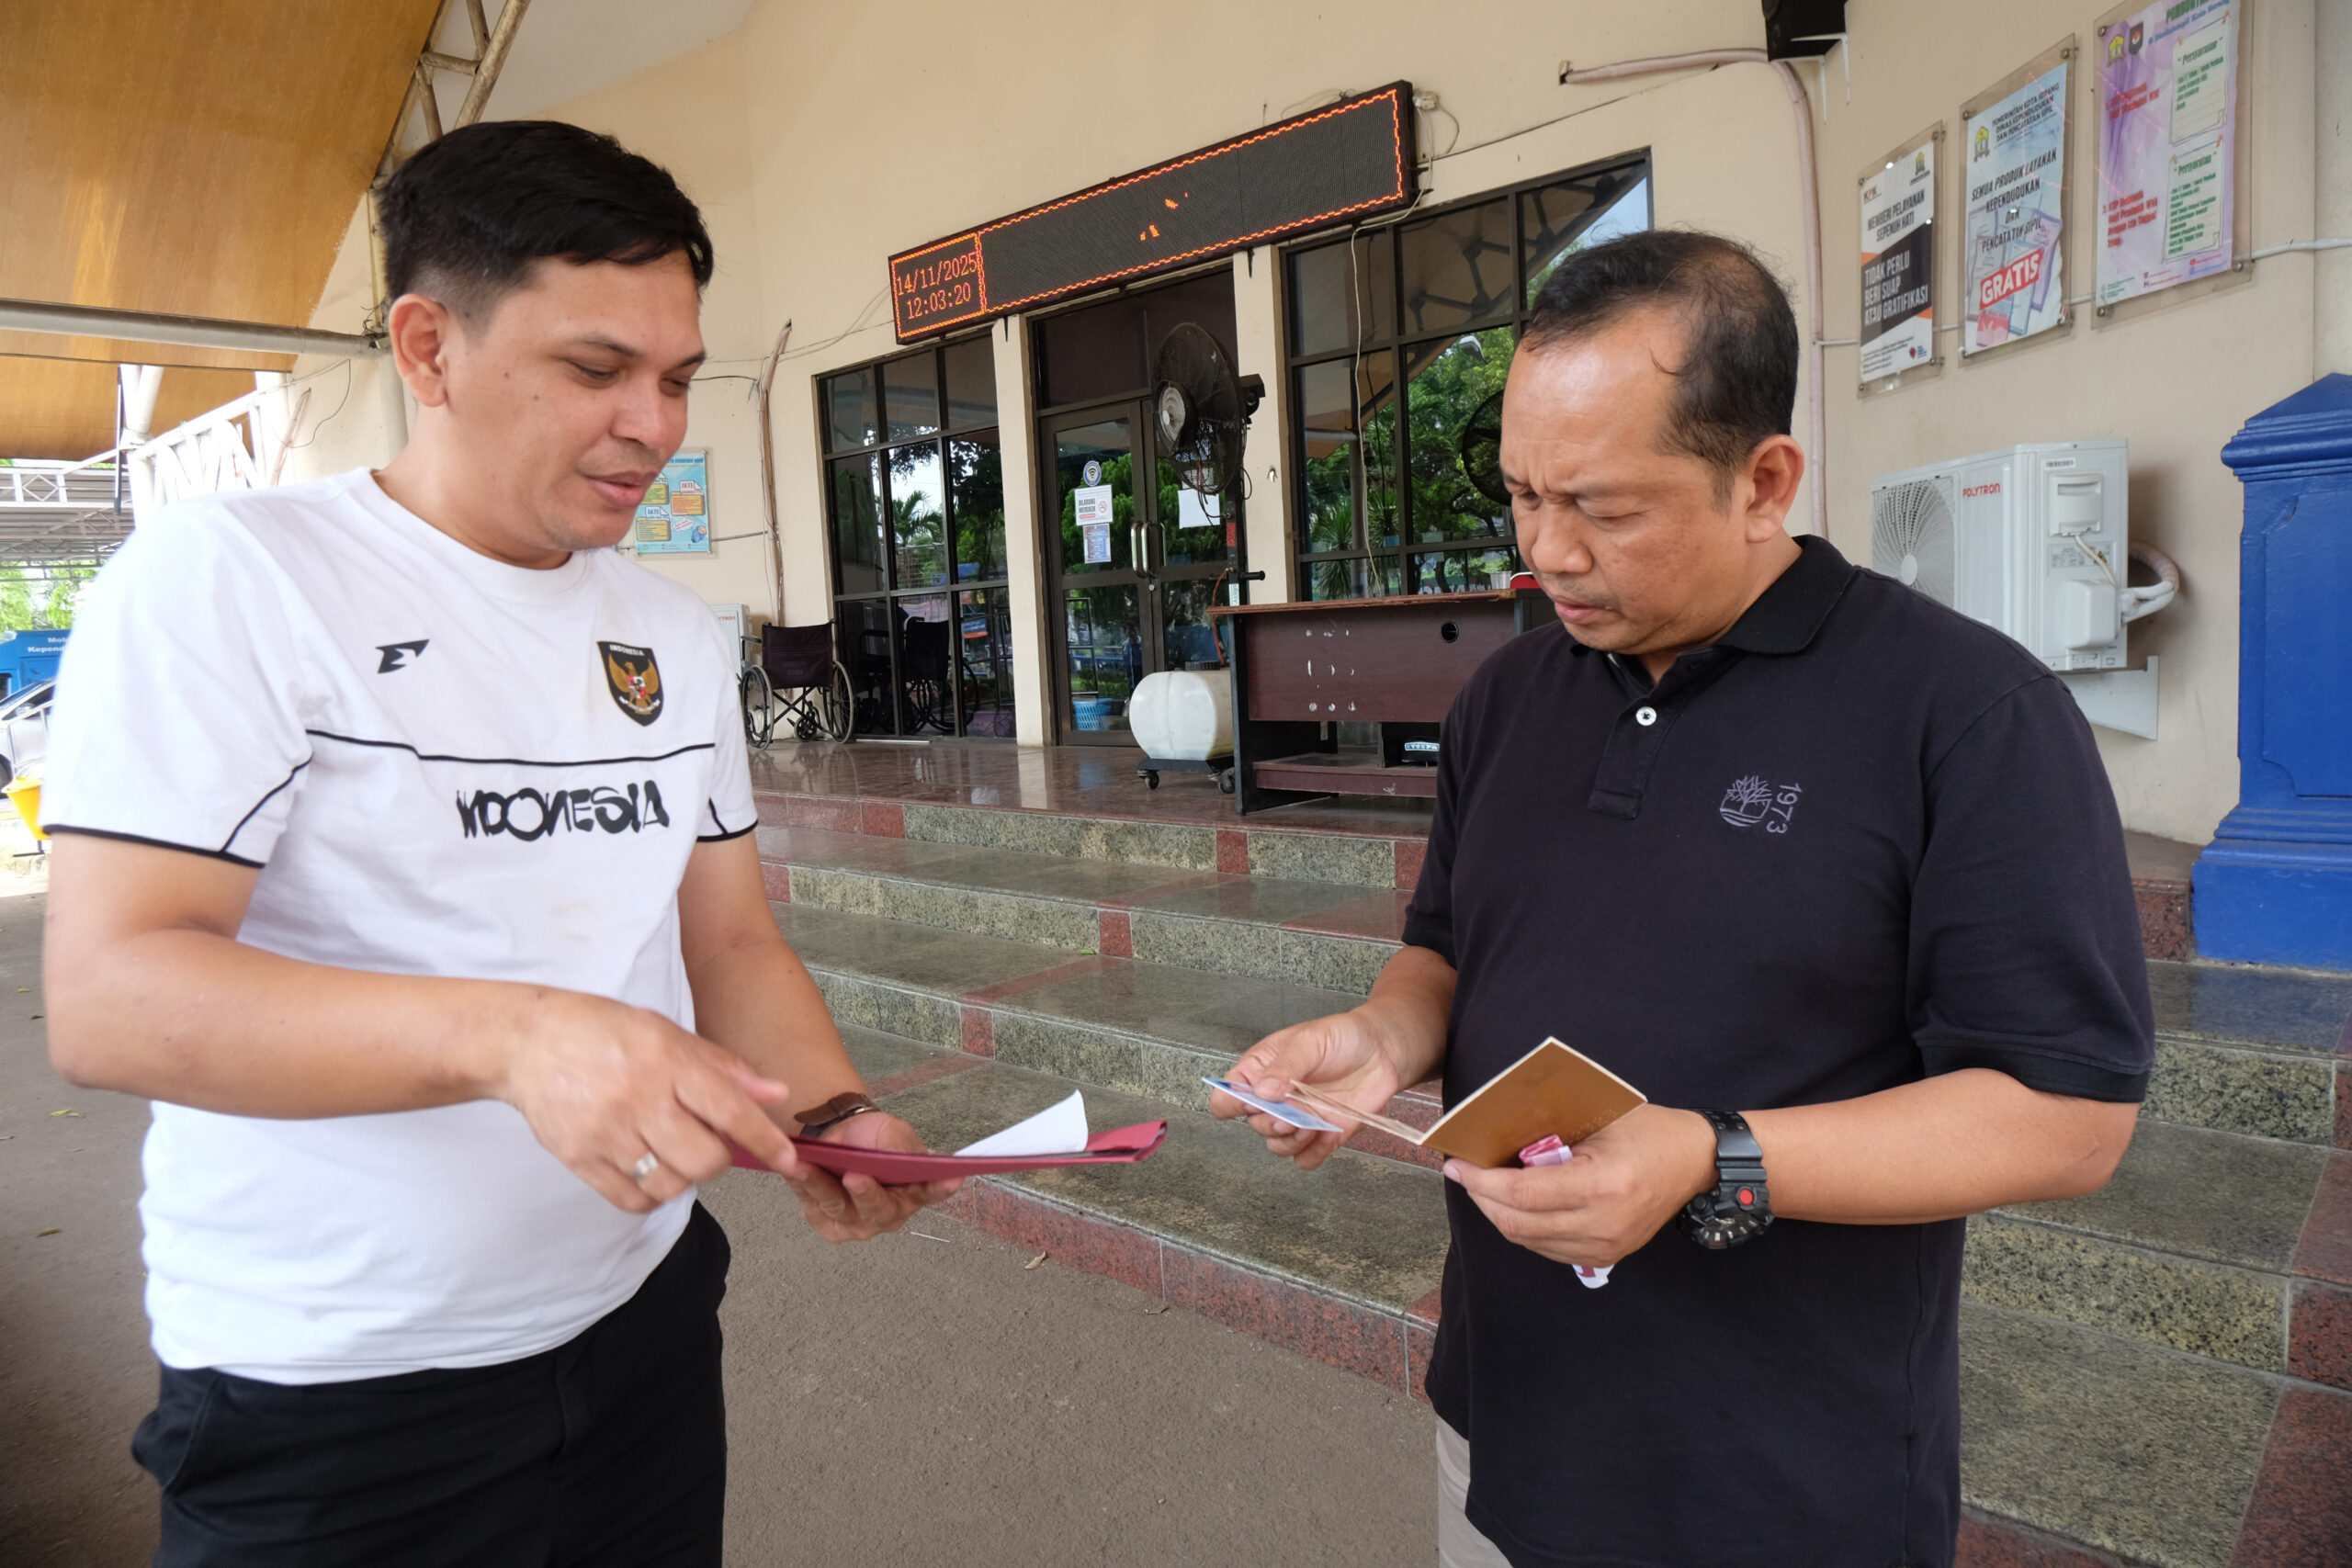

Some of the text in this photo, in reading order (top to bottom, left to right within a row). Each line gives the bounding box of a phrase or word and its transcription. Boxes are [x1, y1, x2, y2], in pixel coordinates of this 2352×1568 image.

[1971, 180, 1994, 202] SEMUA
[1995, 164, 2025, 191] PRODUK
[897, 252, 977, 296] 14/11/2025
[1864, 249, 1911, 288] TIDAK PERLU
[1982, 254, 2040, 304] GRATIS
[907, 282, 972, 320] 12:03:20
[1864, 276, 1902, 308] BERI SUAP
[1883, 283, 1929, 320] GRATIFIKASI
[1962, 483, 2001, 498] POLYTRON
[609, 644, 645, 657] INDONESIA
[456, 780, 670, 841] INDONESIA
[1766, 783, 1803, 834] 1973
